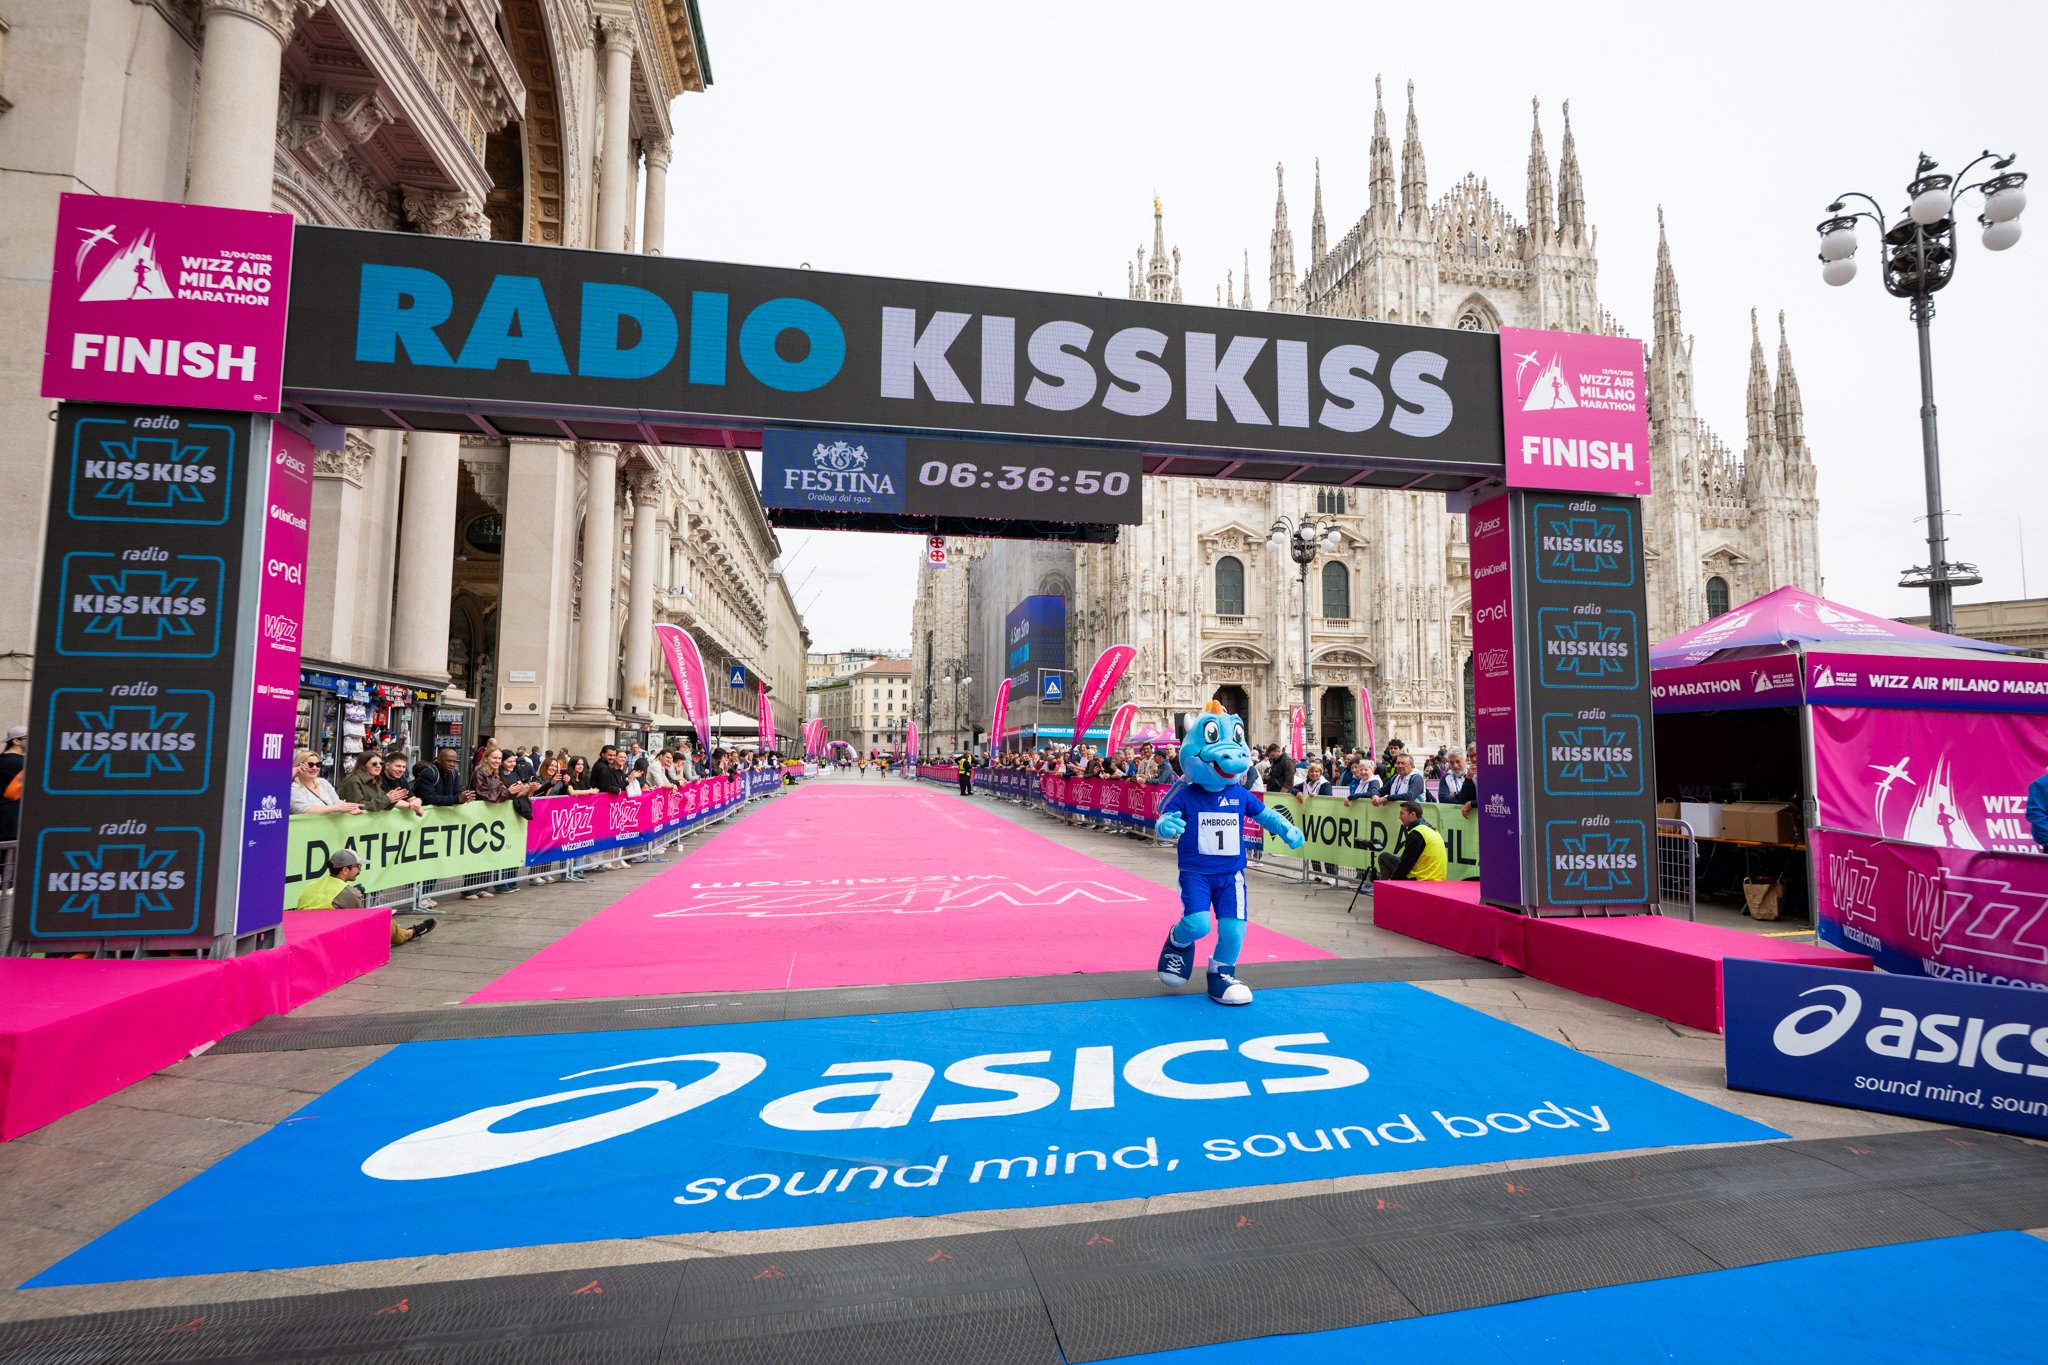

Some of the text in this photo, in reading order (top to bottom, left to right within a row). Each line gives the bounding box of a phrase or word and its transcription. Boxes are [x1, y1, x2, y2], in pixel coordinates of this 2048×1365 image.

[220, 250, 272, 262] 12/04/2026
[181, 256, 272, 276] WIZZ AIR
[179, 271, 271, 293] MILANO
[178, 289, 269, 306] MARATHON
[355, 263, 846, 392] RADIO
[71, 333, 256, 382] FINISH
[1579, 373, 1634, 388] WIZZ AIR
[1580, 386, 1635, 401] MILANO
[1581, 399, 1636, 412] MARATHON
[133, 415, 180, 429] radio
[1521, 435, 1634, 471] FINISH
[285, 456, 305, 474] asics
[784, 468, 896, 495] FESTINA
[919, 461, 1130, 496] 06:36:50
[807, 492, 837, 505] Orologi
[853, 496, 872, 505] 1902
[1568, 501, 1596, 512] radio
[278, 508, 307, 531] UniCredit
[1482, 517, 1501, 533] asics
[122, 547, 169, 562] radio
[268, 559, 302, 585] enel
[1481, 561, 1507, 578] UniCredit
[1476, 600, 1507, 624] enel
[1573, 603, 1601, 615] radio
[1099, 651, 1122, 690] MARATHON
[110, 681, 158, 697] radio
[1669, 678, 1741, 698] MARATHON
[1869, 674, 1908, 689] WIZZ
[1912, 676, 1938, 690] AIR
[1942, 678, 2000, 693] MILANO
[1577, 708, 1606, 720] radio
[262, 733, 283, 759] FIAT
[1487, 744, 1504, 765] FIAT
[253, 808, 282, 821] FESTINA
[1485, 804, 1511, 815] FESTINA
[99, 819, 147, 835] radio
[1201, 818, 1238, 828] AMBROGIO
[1581, 814, 1610, 827] radio
[1215, 831, 1224, 850] 1
[1302, 814, 1388, 852] WORLD
[561, 839, 595, 852] wizzair.com
[691, 874, 1010, 890] wizzair.com
[1842, 922, 1882, 953] wizzair.com
[759, 1031, 1369, 1131] asics
[1854, 1075, 1921, 1098] sound
[1925, 1084, 1984, 1109] mind,
[673, 1100, 1611, 1206] sound mind, sound body
